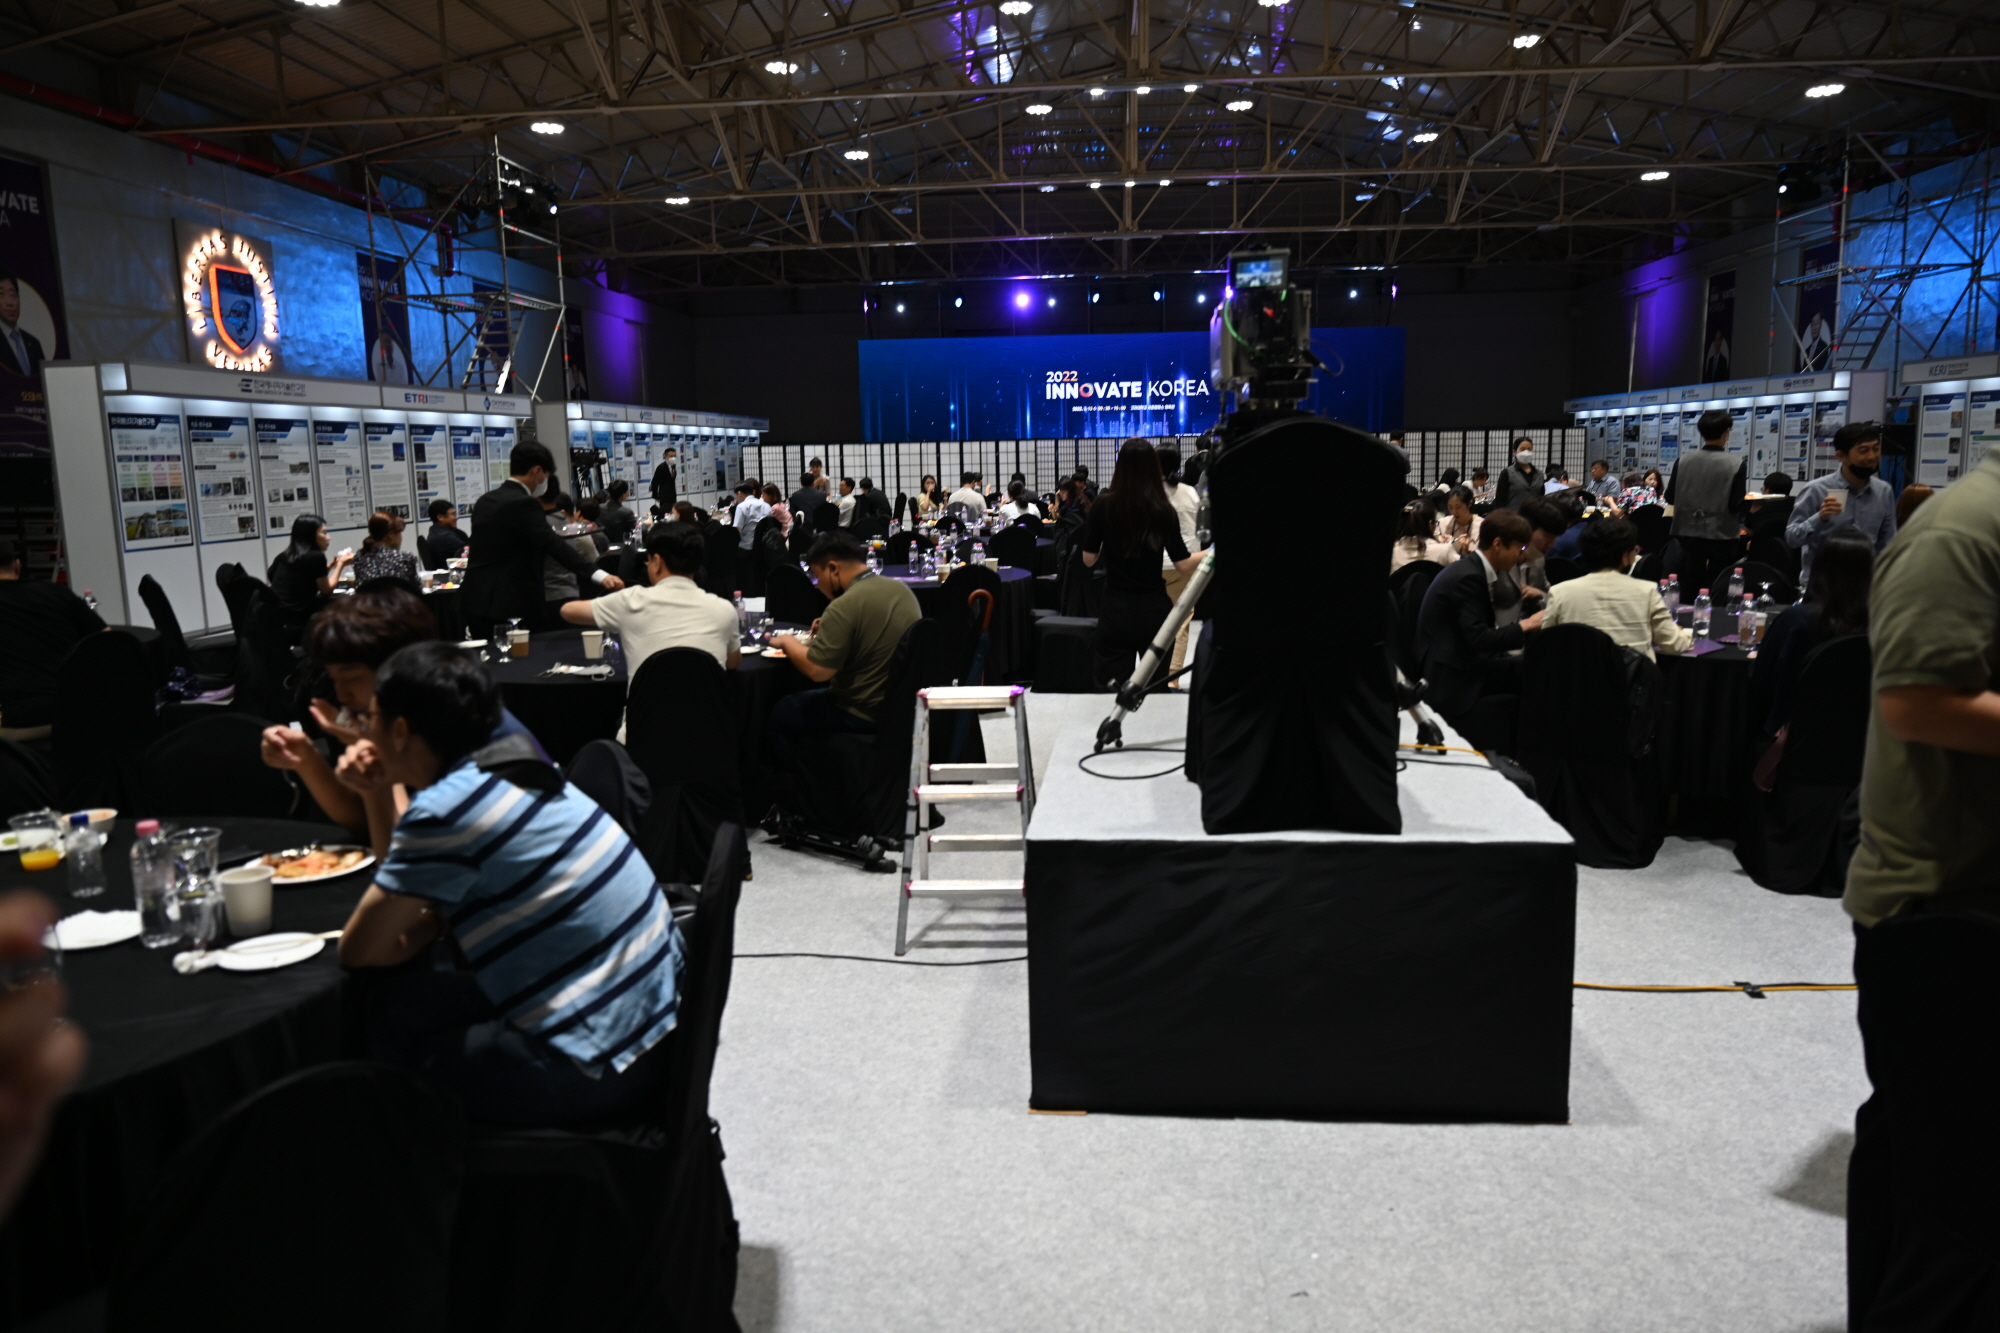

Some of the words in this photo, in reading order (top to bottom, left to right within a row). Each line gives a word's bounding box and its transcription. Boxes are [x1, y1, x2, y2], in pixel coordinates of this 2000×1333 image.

[191, 234, 228, 330] LIBERTAS
[1046, 371, 1079, 383] 2022
[1046, 381, 1143, 400] INNOVATE
[1148, 379, 1210, 397] KOREA
[404, 393, 429, 404] ETRI
